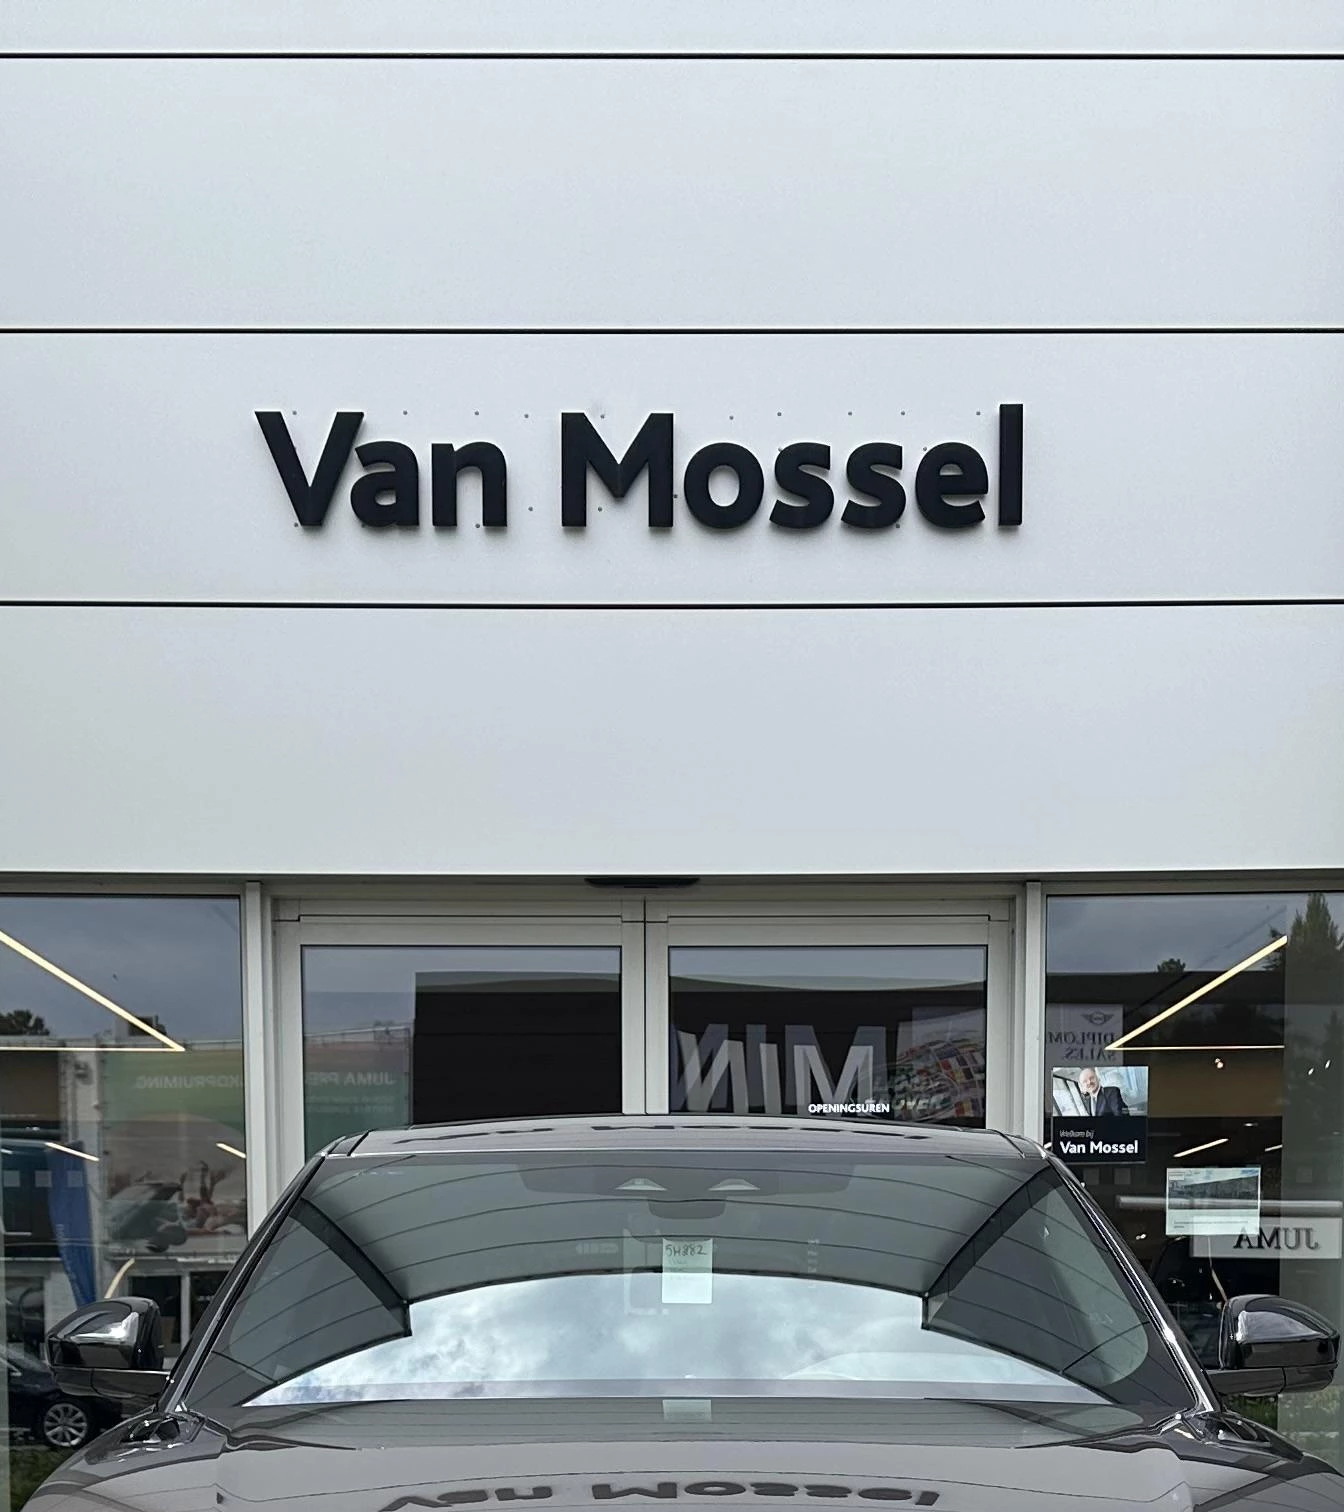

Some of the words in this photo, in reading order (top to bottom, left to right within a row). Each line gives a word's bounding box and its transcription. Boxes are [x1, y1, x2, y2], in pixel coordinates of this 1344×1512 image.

[254, 410, 508, 527] Van
[561, 403, 1024, 528] Mossel
[808, 1103, 890, 1113] OPENINGSUREN
[1059, 1141, 1086, 1153] Van
[1090, 1139, 1138, 1153] Mossel
